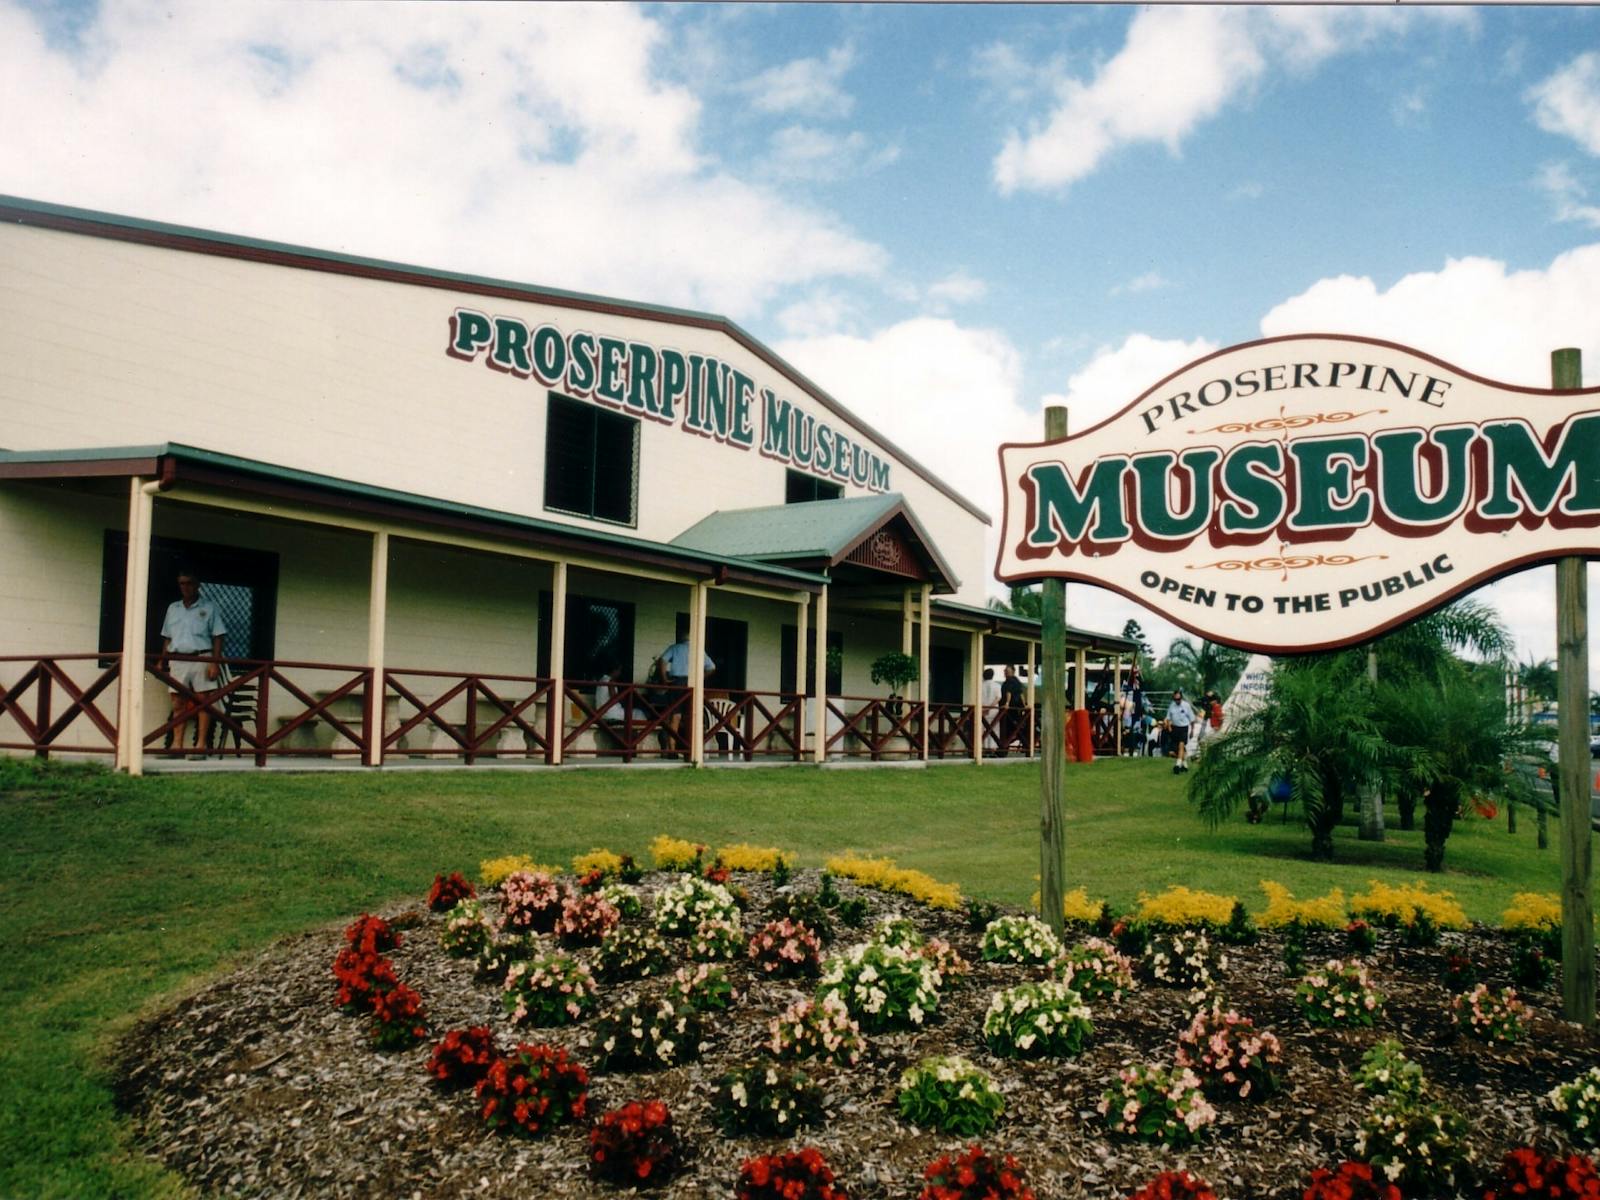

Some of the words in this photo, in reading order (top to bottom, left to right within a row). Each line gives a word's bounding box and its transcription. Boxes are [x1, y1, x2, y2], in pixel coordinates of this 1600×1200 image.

[447, 308, 755, 450] PROSERPINE
[760, 387, 891, 492] MUSEUM
[1138, 361, 1453, 435] PROSERPINE
[1017, 409, 1600, 560] MUSEUM
[1140, 570, 1217, 608] OPEN
[1224, 592, 1264, 614] TO
[1273, 592, 1331, 614] THE
[1338, 553, 1454, 608] PUBLIC
